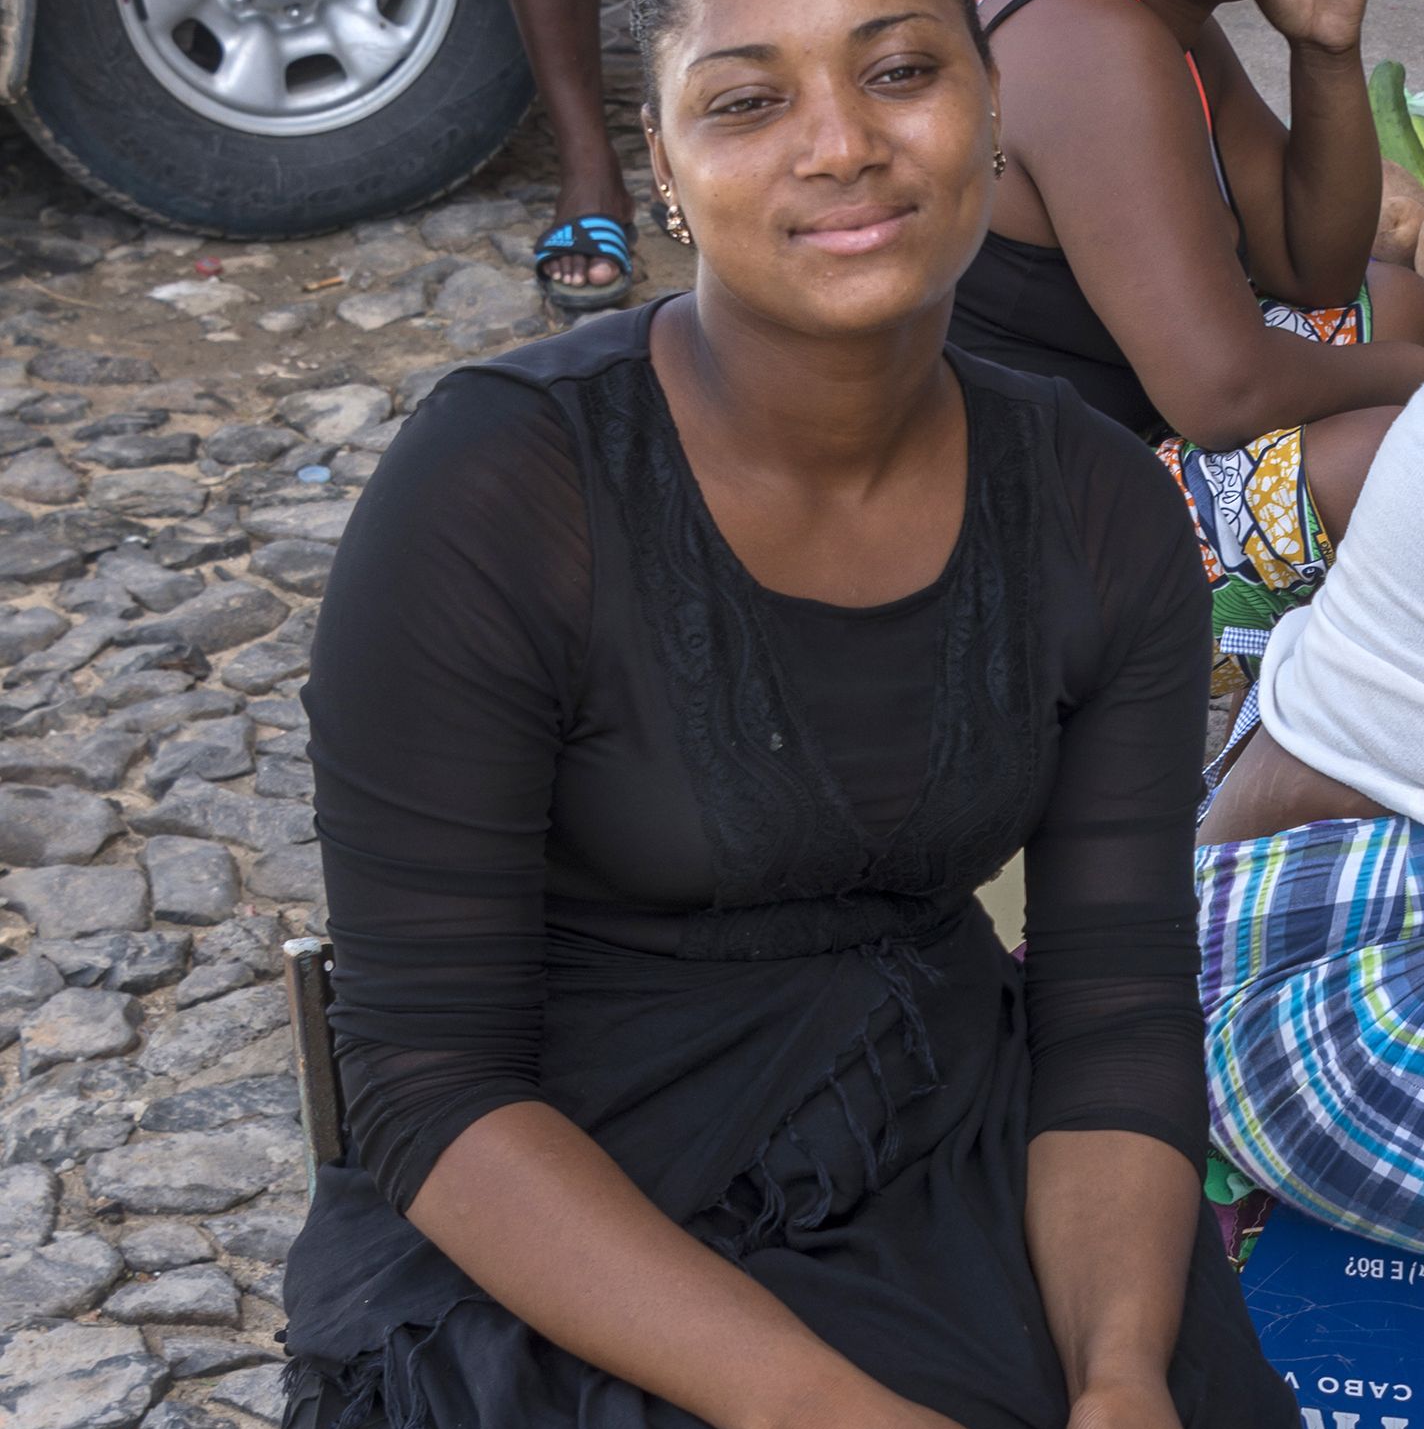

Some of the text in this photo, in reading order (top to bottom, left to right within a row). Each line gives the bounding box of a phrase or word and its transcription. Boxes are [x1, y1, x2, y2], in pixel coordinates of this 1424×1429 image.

[1345, 1257, 1385, 1280] Bô?
[1391, 1260, 1404, 1280] E
[1317, 1376, 1412, 1401] CABO
